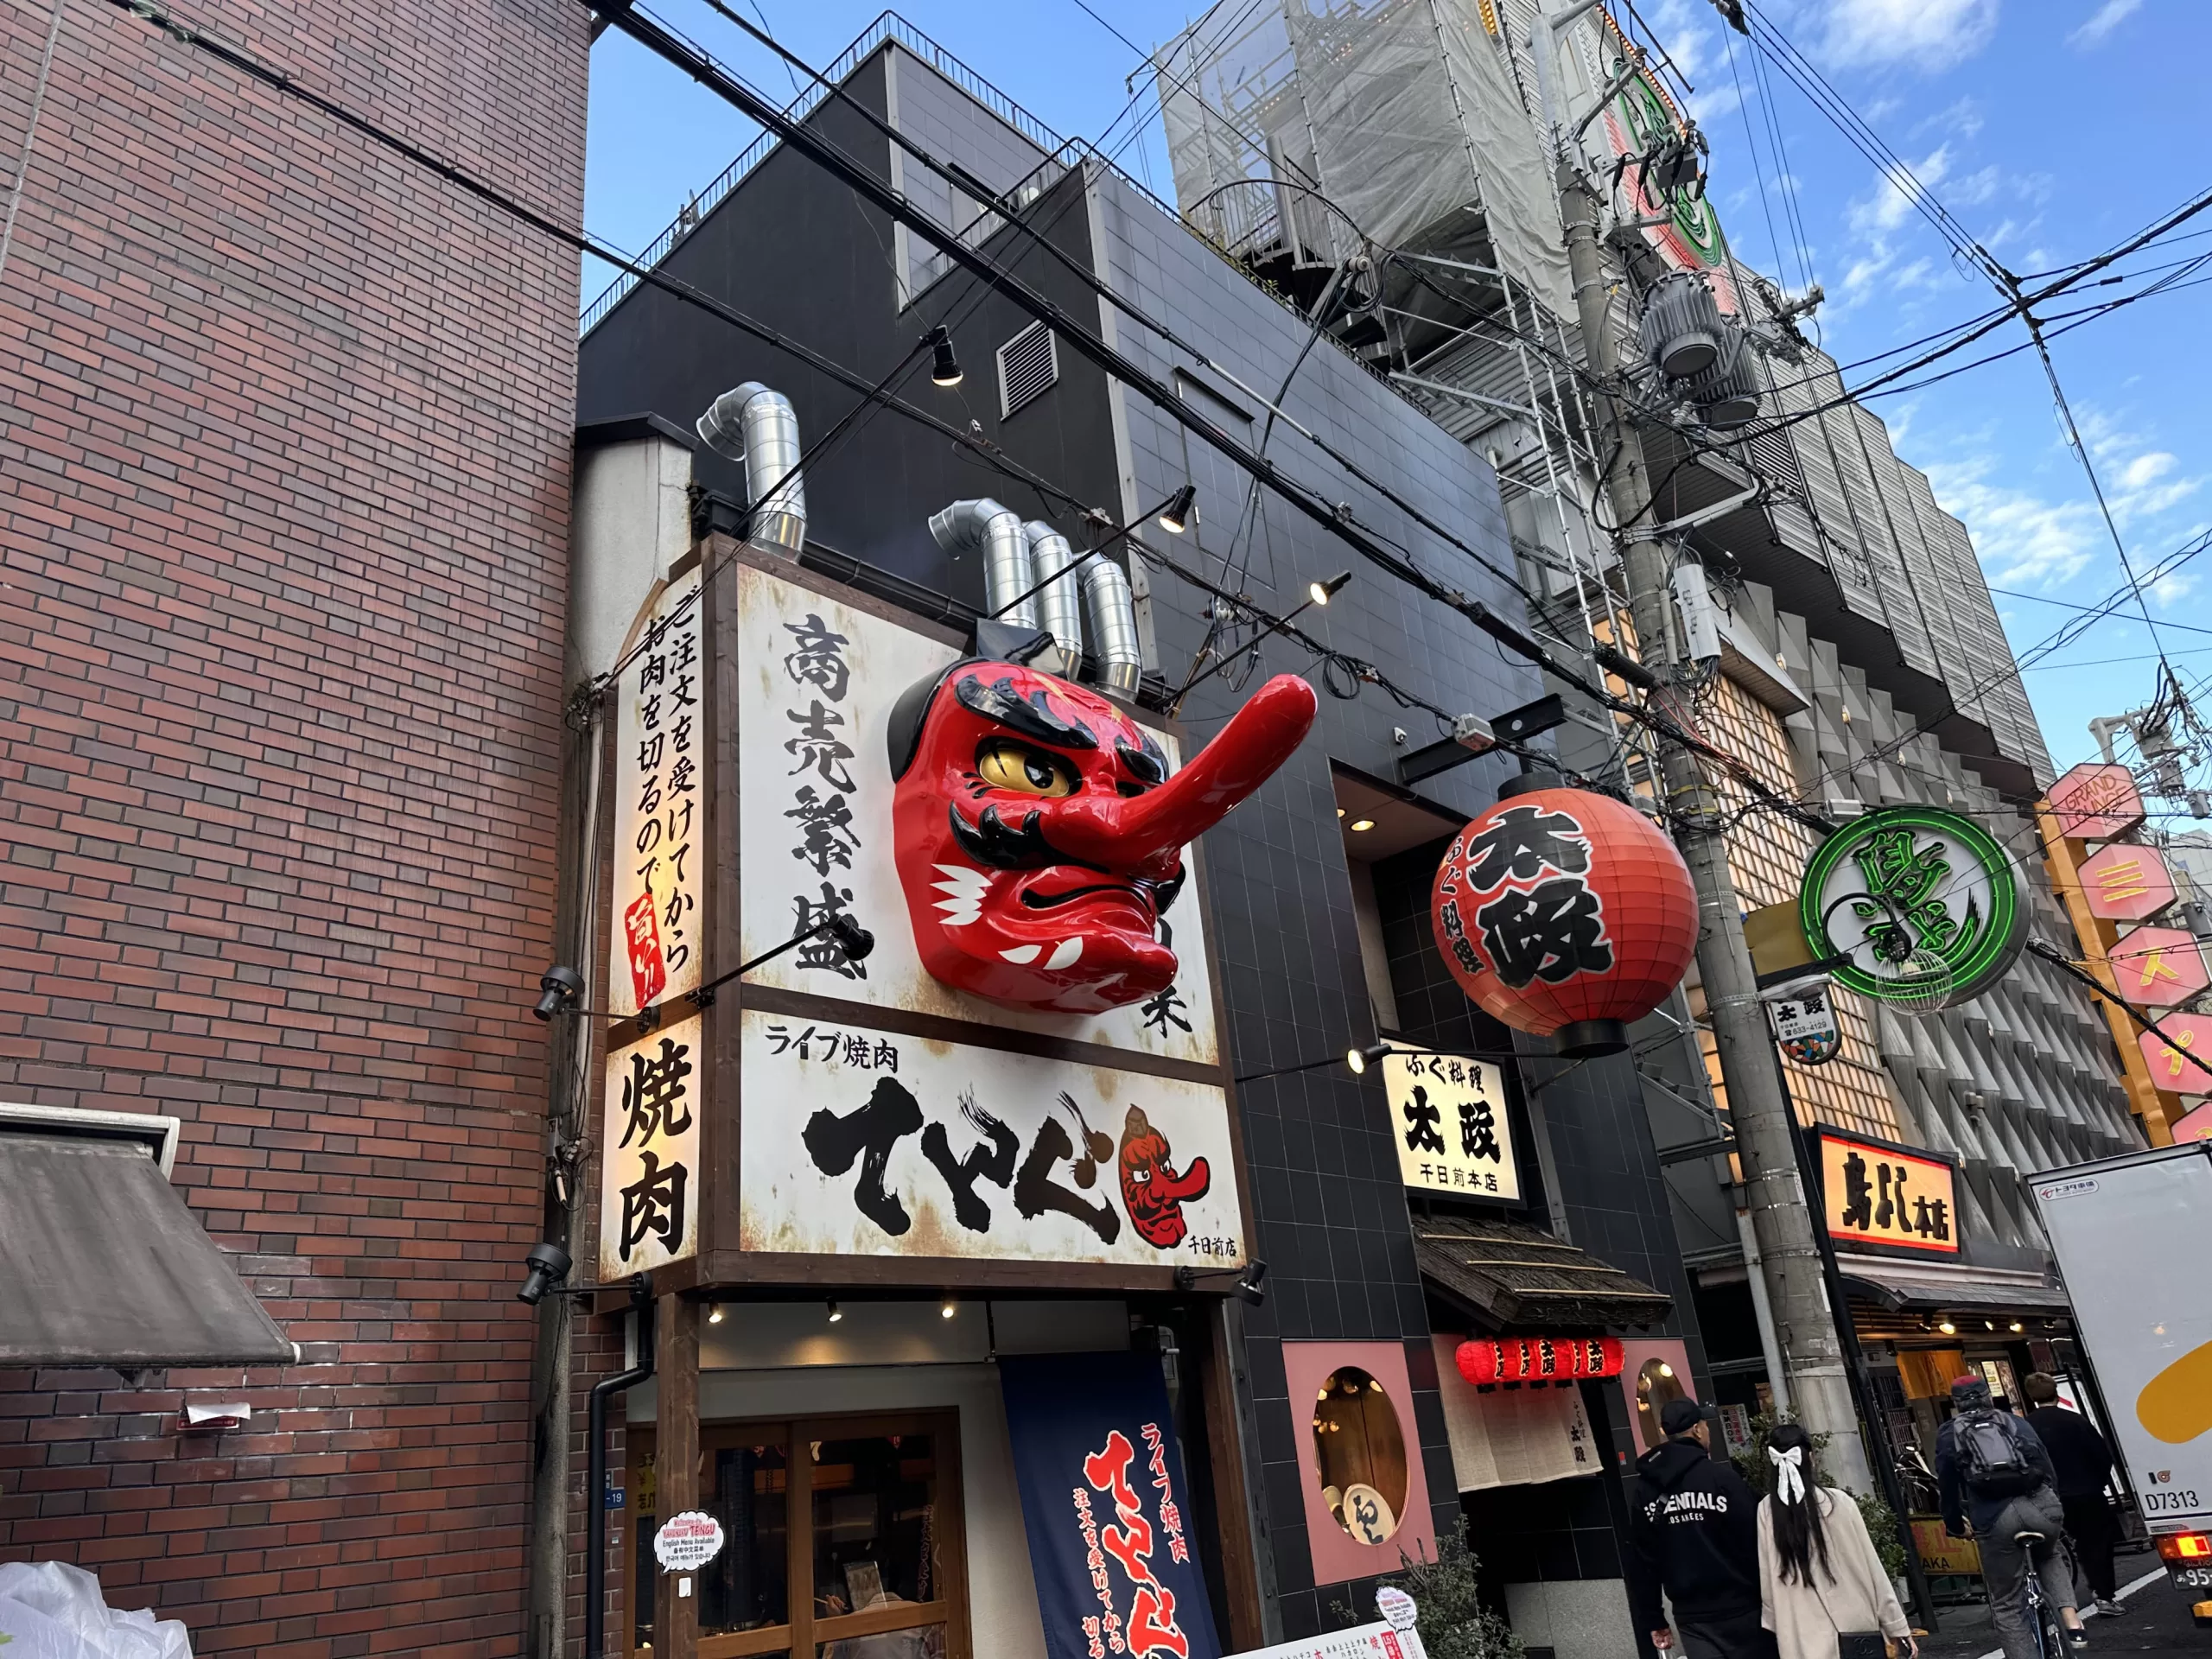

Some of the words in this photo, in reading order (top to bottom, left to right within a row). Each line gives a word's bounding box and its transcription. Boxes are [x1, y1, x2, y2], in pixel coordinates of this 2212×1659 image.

[636, 615, 666, 894] お肉を切るので
[663, 585, 697, 973] ご注文を受けてから
[783, 613, 867, 980] 商売繁盛
[2064, 774, 2116, 810] GRAND
[765, 1026, 899, 1073] ライブ焼肉
[1405, 1053, 1485, 1095] ふぐ料理
[1402, 1084, 1502, 1165] 太政
[618, 1037, 694, 1262] 焼肉
[801, 1076, 1121, 1246] てんぐ
[1420, 1163, 1498, 1192] 千日前本店
[1188, 1235, 1237, 1258] 千日前店
[2145, 1490, 2199, 1511] D7313
[663, 1539, 680, 1548] English
[690, 1522, 716, 1536] TENGU
[1072, 1487, 1126, 1654] 注文を受けてから
[1922, 1556, 1951, 1569] AKA
[1082, 1615, 1106, 1659] 切る
